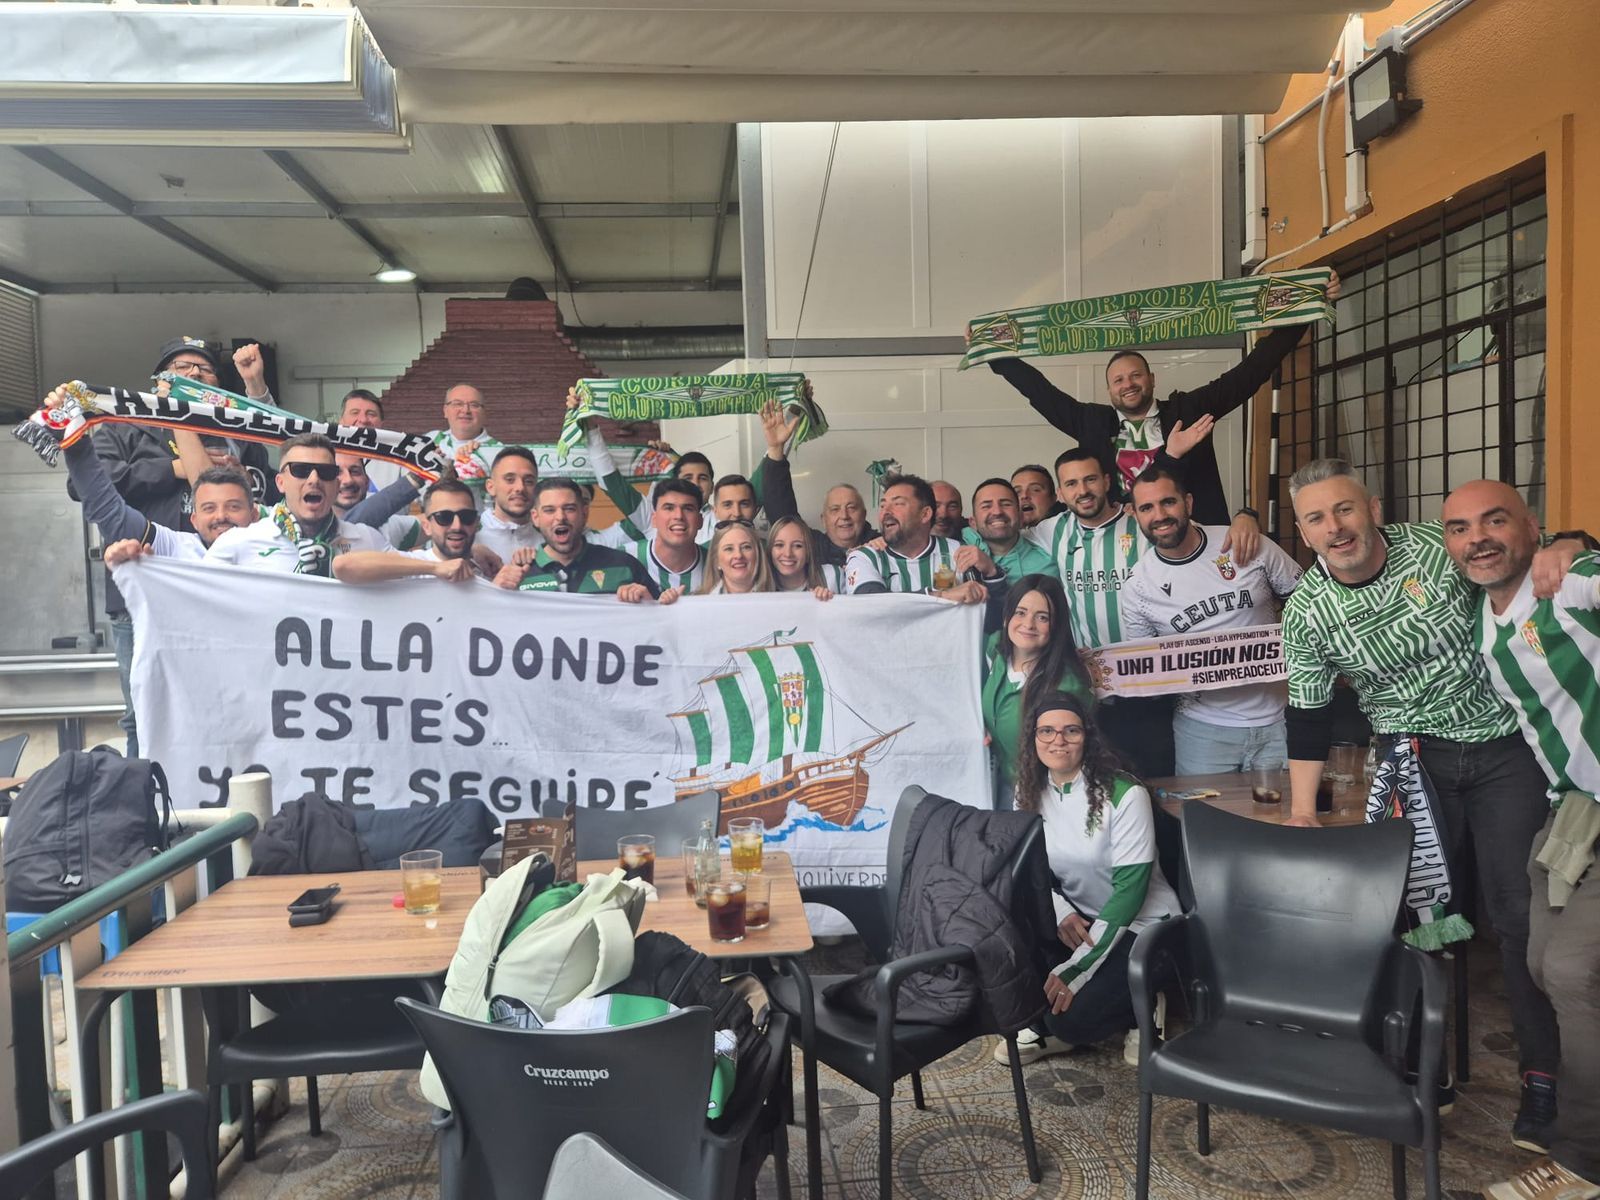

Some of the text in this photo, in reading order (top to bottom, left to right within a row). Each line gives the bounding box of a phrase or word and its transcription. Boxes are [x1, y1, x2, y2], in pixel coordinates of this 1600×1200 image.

[1049, 281, 1217, 327] CORDOBA
[1037, 302, 1238, 352] CLUB DE FUTBOL
[608, 391, 665, 421] CLUB
[669, 399, 698, 420] DE
[113, 388, 192, 421] AD
[390, 431, 443, 472] FC
[519, 580, 558, 591] GIVOVA
[1073, 582, 1122, 592] ICTORIO
[1170, 589, 1254, 633] CEUTA
[1327, 609, 1378, 634] GIVOVA
[274, 615, 664, 687] ALLÁ DONDE
[1185, 636, 1211, 647] ASCENSO
[1214, 635, 1229, 643] LIGA
[1228, 630, 1270, 642] HYPERMOTION
[1117, 641, 1281, 677] UNA ILUSIÓN NOS
[197, 763, 272, 809] Y
[300, 766, 376, 811] TE
[523, 1063, 610, 1082] Cruzcampo
